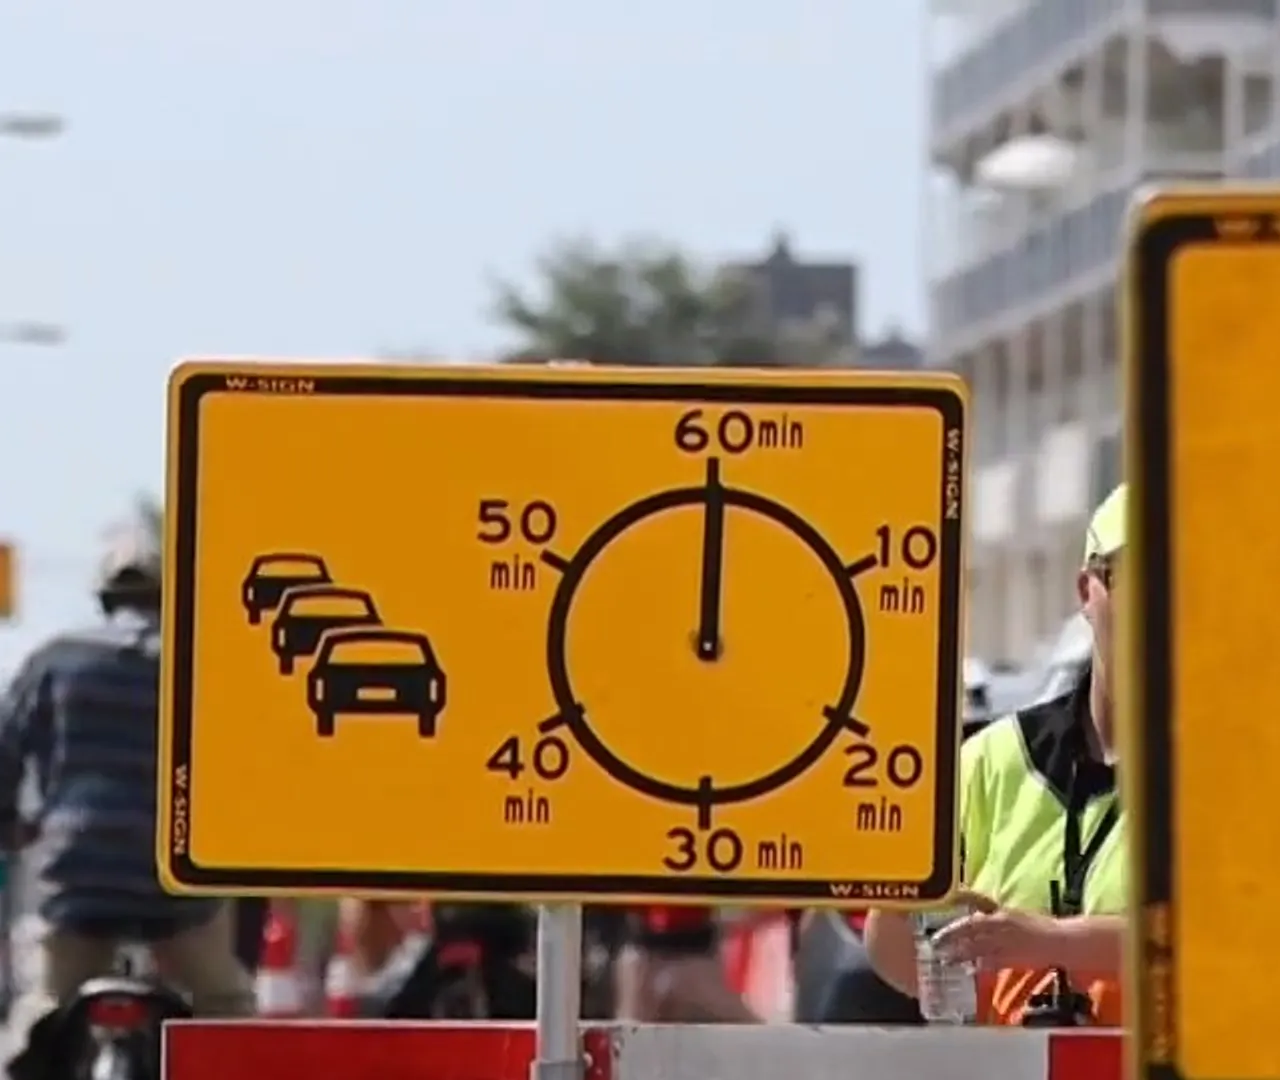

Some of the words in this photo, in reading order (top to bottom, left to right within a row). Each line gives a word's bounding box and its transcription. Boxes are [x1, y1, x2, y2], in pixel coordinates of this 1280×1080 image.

[225, 374, 315, 393] W-SIGN
[946, 427, 960, 520] W-SIGN
[477, 499, 557, 545] 50
[874, 525, 938, 570] 10
[490, 557, 535, 590] min
[879, 579, 925, 614] min
[486, 735, 570, 781] 40
[842, 743, 923, 788] 20
[173, 764, 188, 856] W-SIGN
[504, 790, 549, 824] min
[857, 798, 902, 832] min
[663, 828, 743, 873] 30
[758, 834, 803, 870] min
[829, 883, 920, 899] W-SIGN
